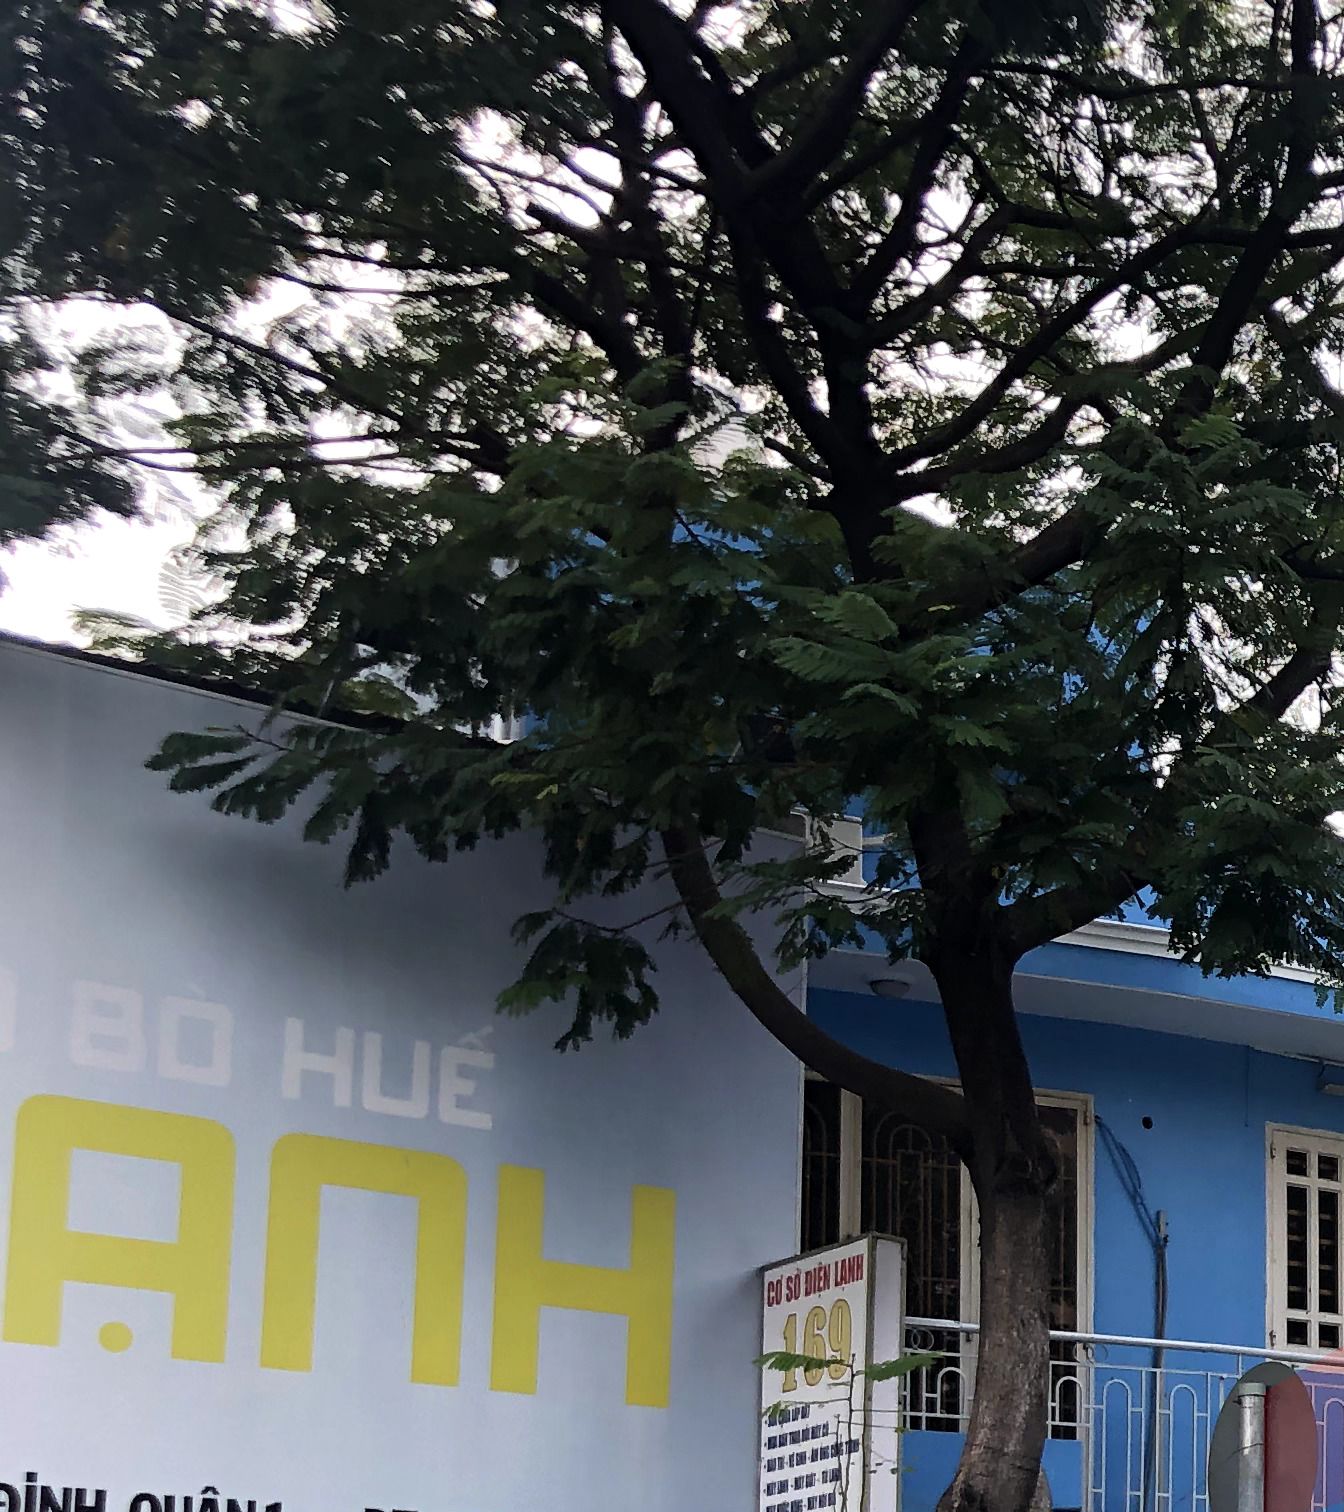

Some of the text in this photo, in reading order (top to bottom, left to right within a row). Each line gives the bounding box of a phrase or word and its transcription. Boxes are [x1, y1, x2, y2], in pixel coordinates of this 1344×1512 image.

[281, 1016, 495, 1130] HUẾ
[835, 1253, 864, 1292] LẠNH
[782, 1298, 852, 1393] 169
